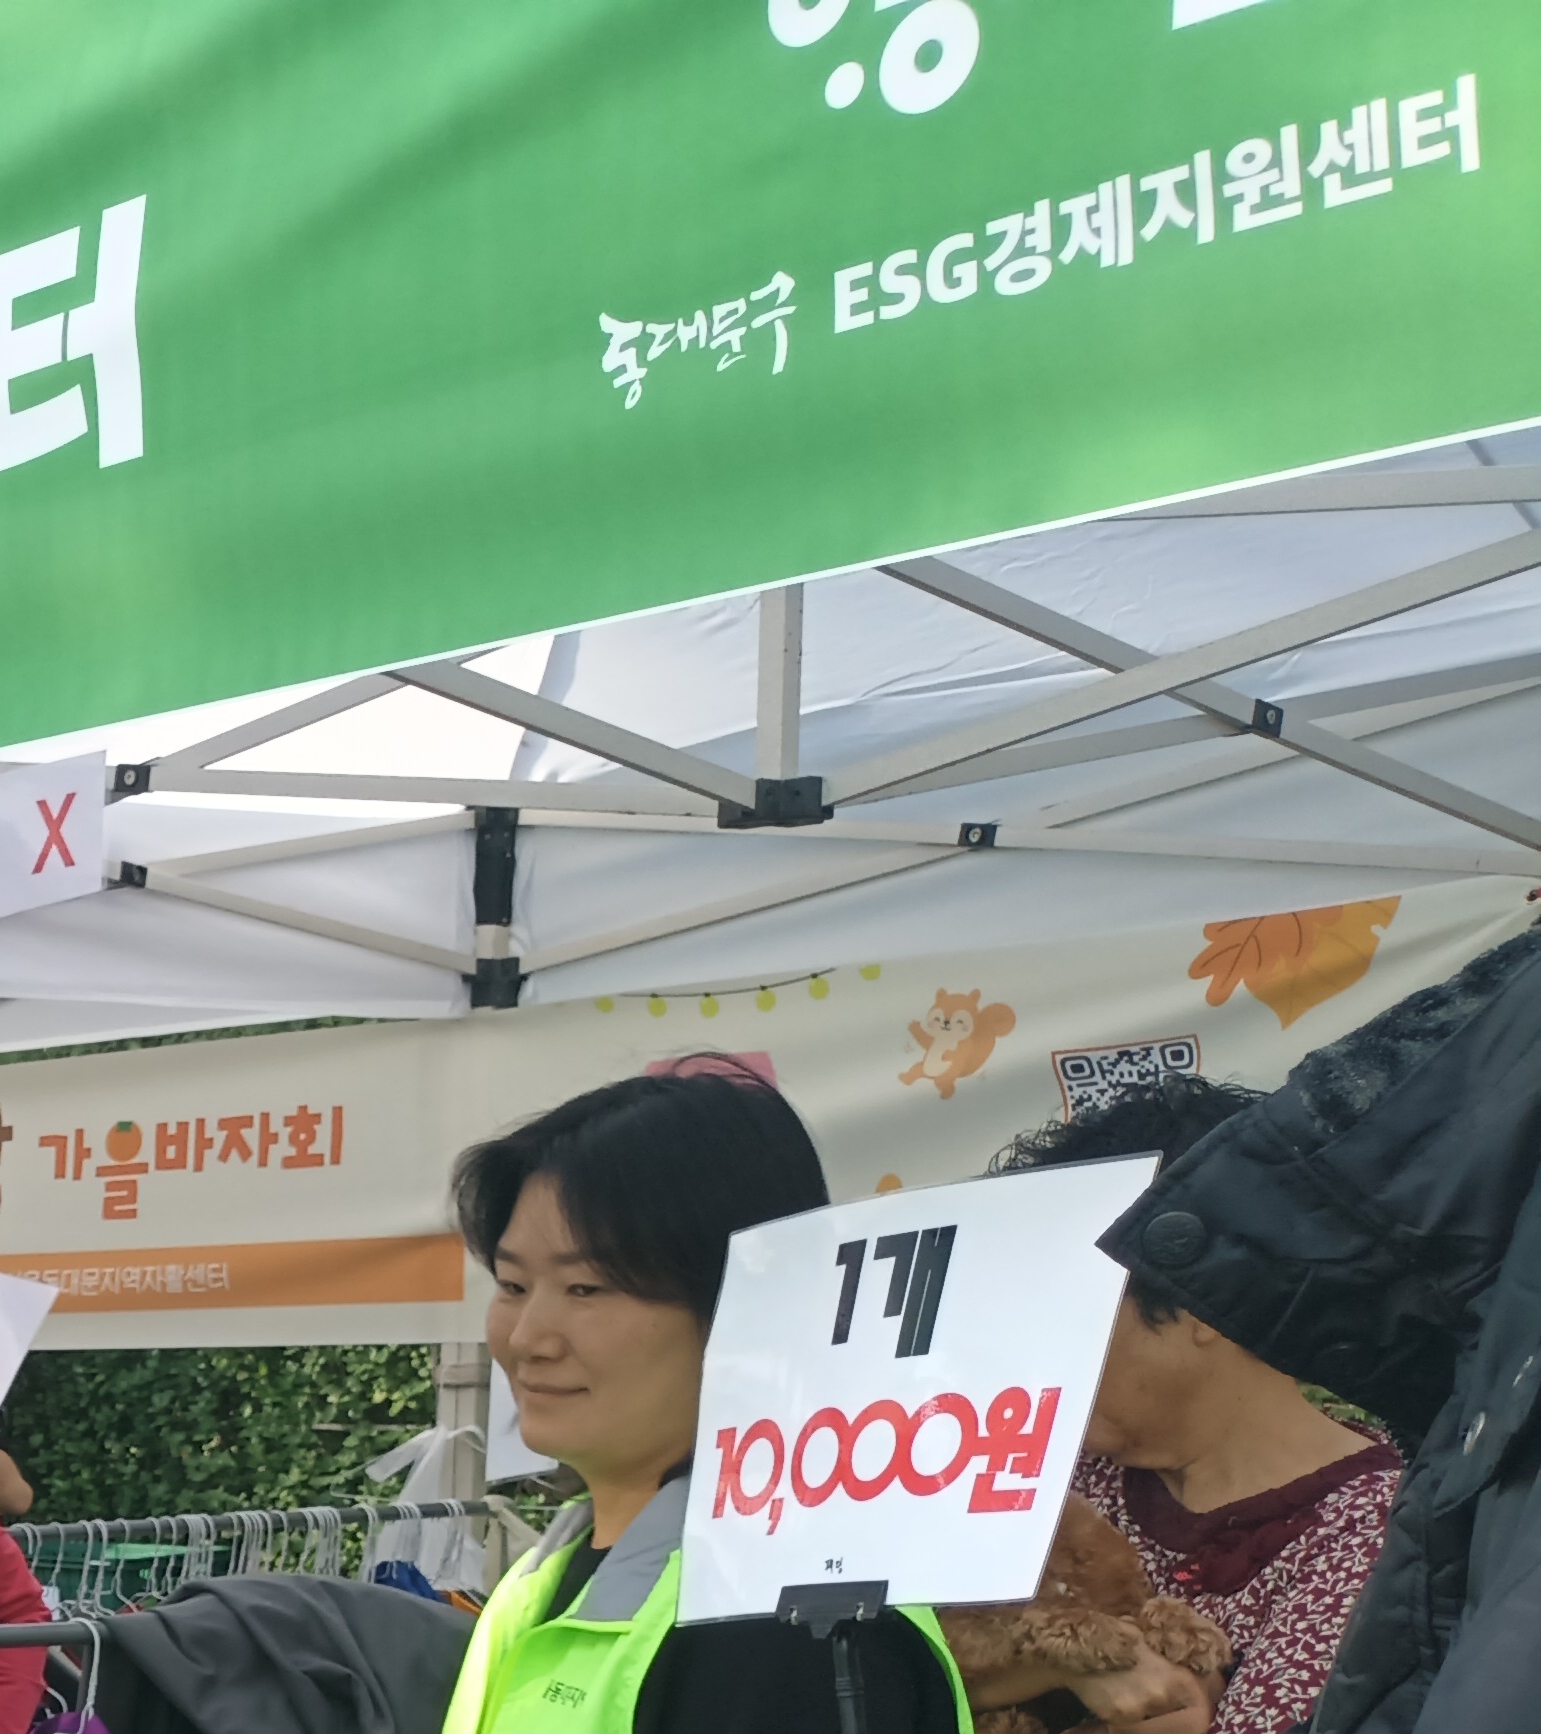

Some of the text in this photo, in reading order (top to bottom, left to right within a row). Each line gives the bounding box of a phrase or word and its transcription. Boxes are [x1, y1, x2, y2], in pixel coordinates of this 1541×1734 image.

[599, 74, 1482, 409] 동대문구 ESG경제지원센터
[31, 791, 78, 876] X
[37, 1104, 344, 1221] 가을바자회
[831, 1224, 959, 1360] 1개
[711, 1386, 1063, 1536] 10,000원
